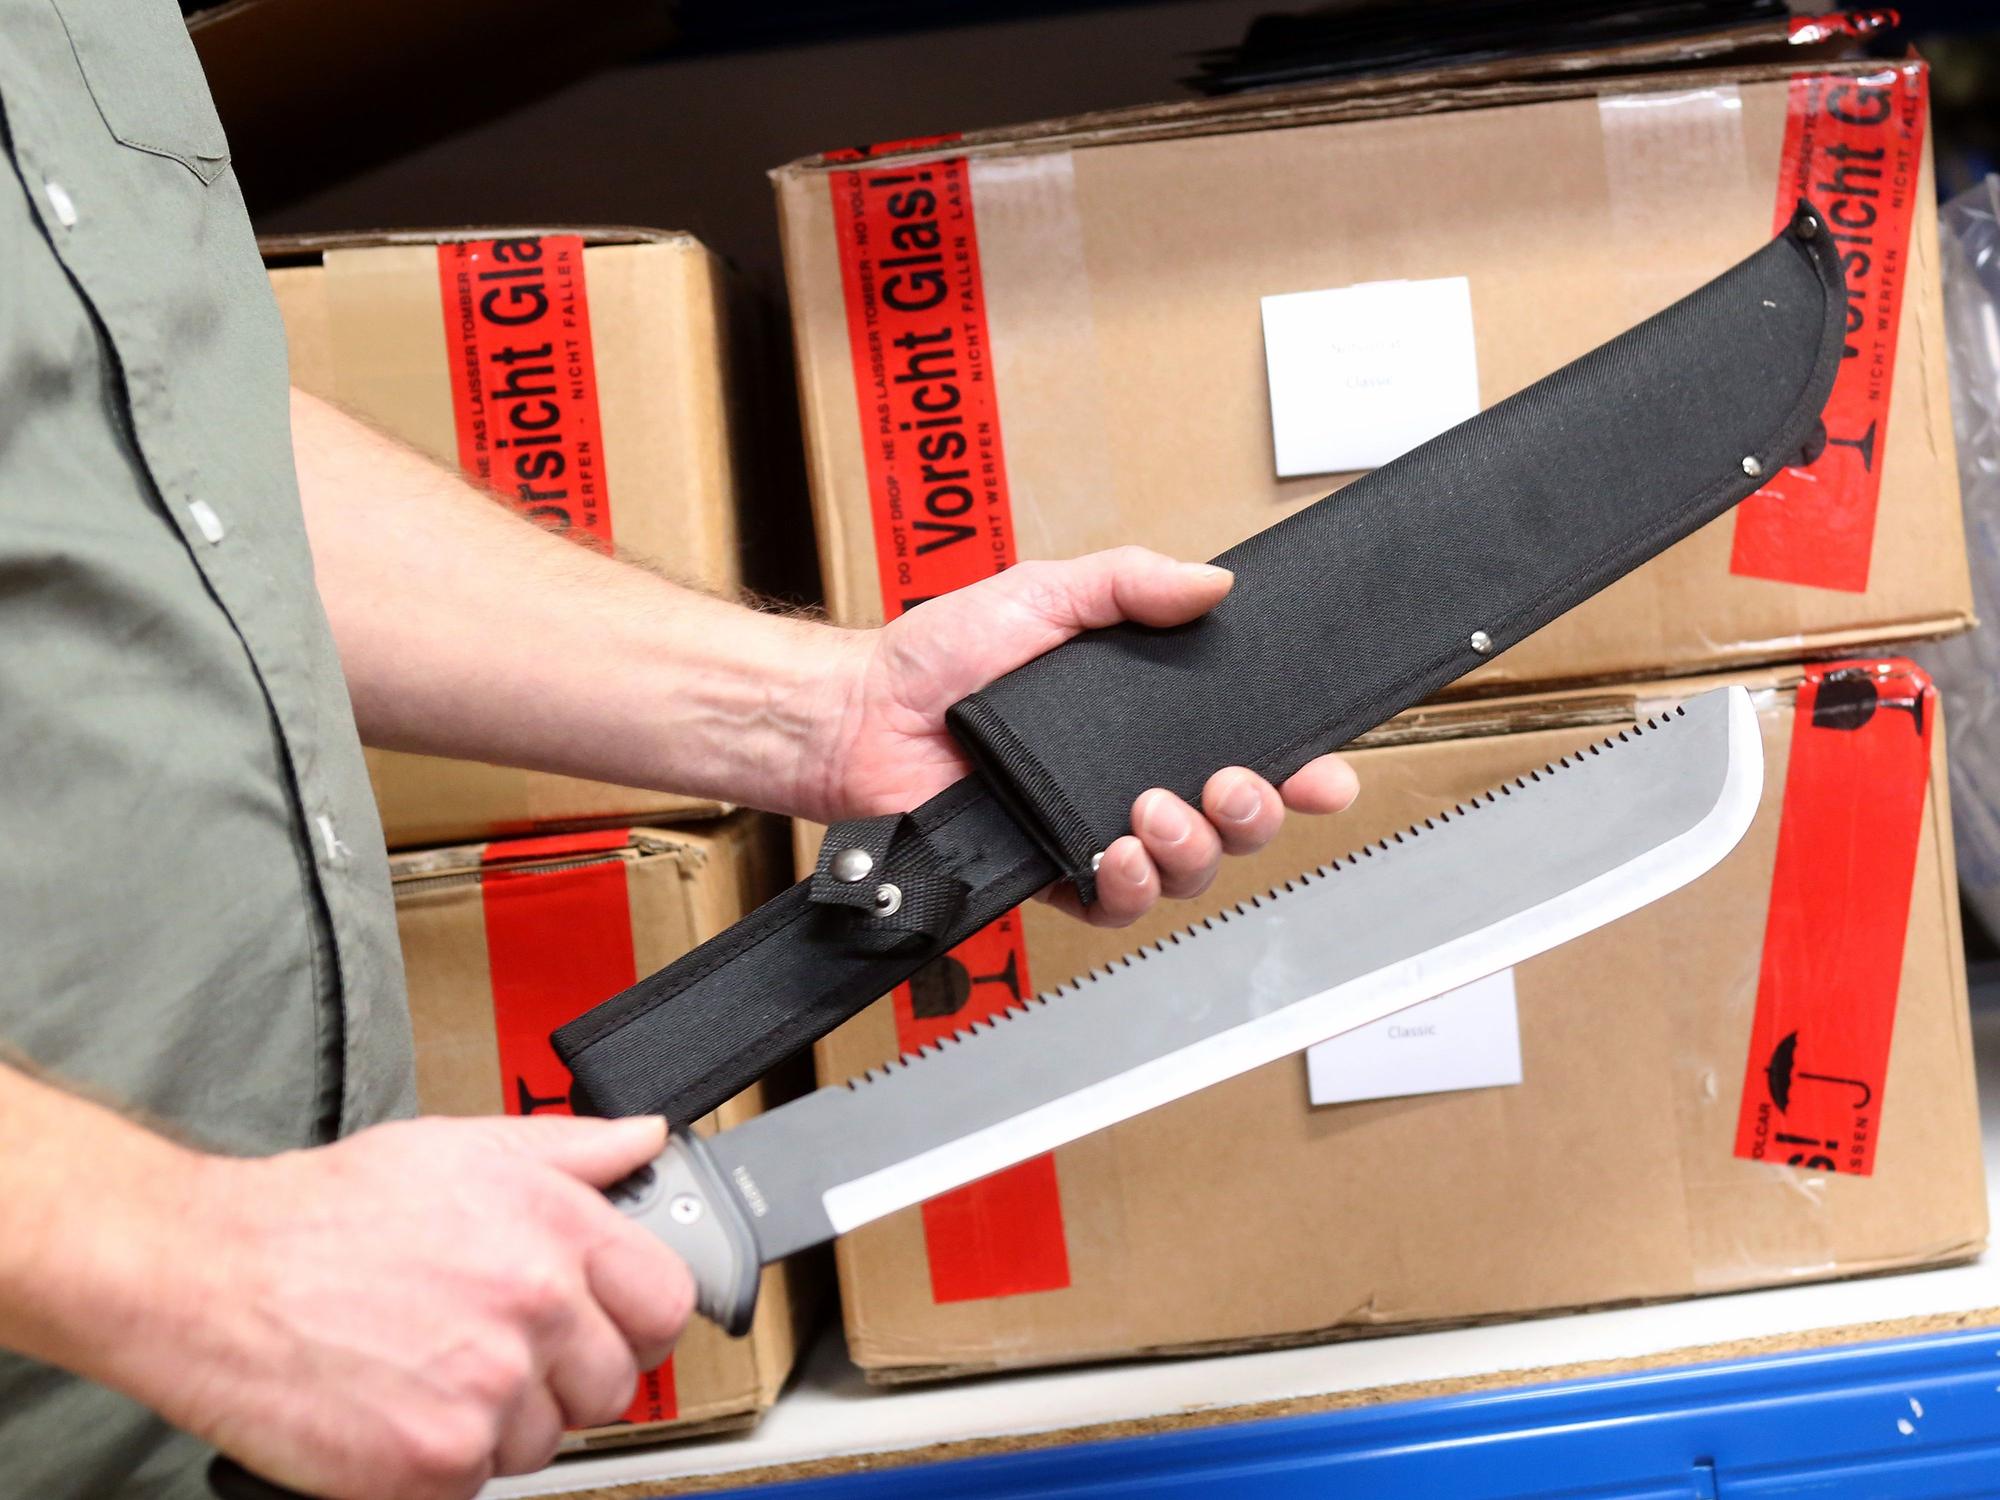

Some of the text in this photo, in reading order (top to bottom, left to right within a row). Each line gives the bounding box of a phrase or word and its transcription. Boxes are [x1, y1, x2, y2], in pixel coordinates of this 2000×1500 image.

[854, 222, 868, 246] NO
[1878, 250, 1897, 331] WERFEN
[1892, 149, 1910, 208] NICHT
[859, 259, 878, 327] TOMBER
[954, 236, 974, 313] FALLEN
[457, 272, 477, 341] TOMBER
[465, 345, 485, 416] LAISSER
[869, 171, 977, 556] Vorsicht Glas!
[869, 330, 888, 399] LAISSER
[963, 323, 983, 382] NICHT
[557, 251, 597, 526] WERFEN NICHT FALLEN
[877, 403, 892, 434] PAS
[473, 419, 489, 451] PAS
[491, 342, 572, 530] orsicht
[881, 439, 896, 461] NE
[978, 422, 998, 505] WERFEN
[476, 457, 491, 478] NE
[887, 475, 903, 520] DROP
[893, 526, 907, 557] NOT
[897, 562, 912, 585] DO
[1388, 1023, 1437, 1039] Classic
